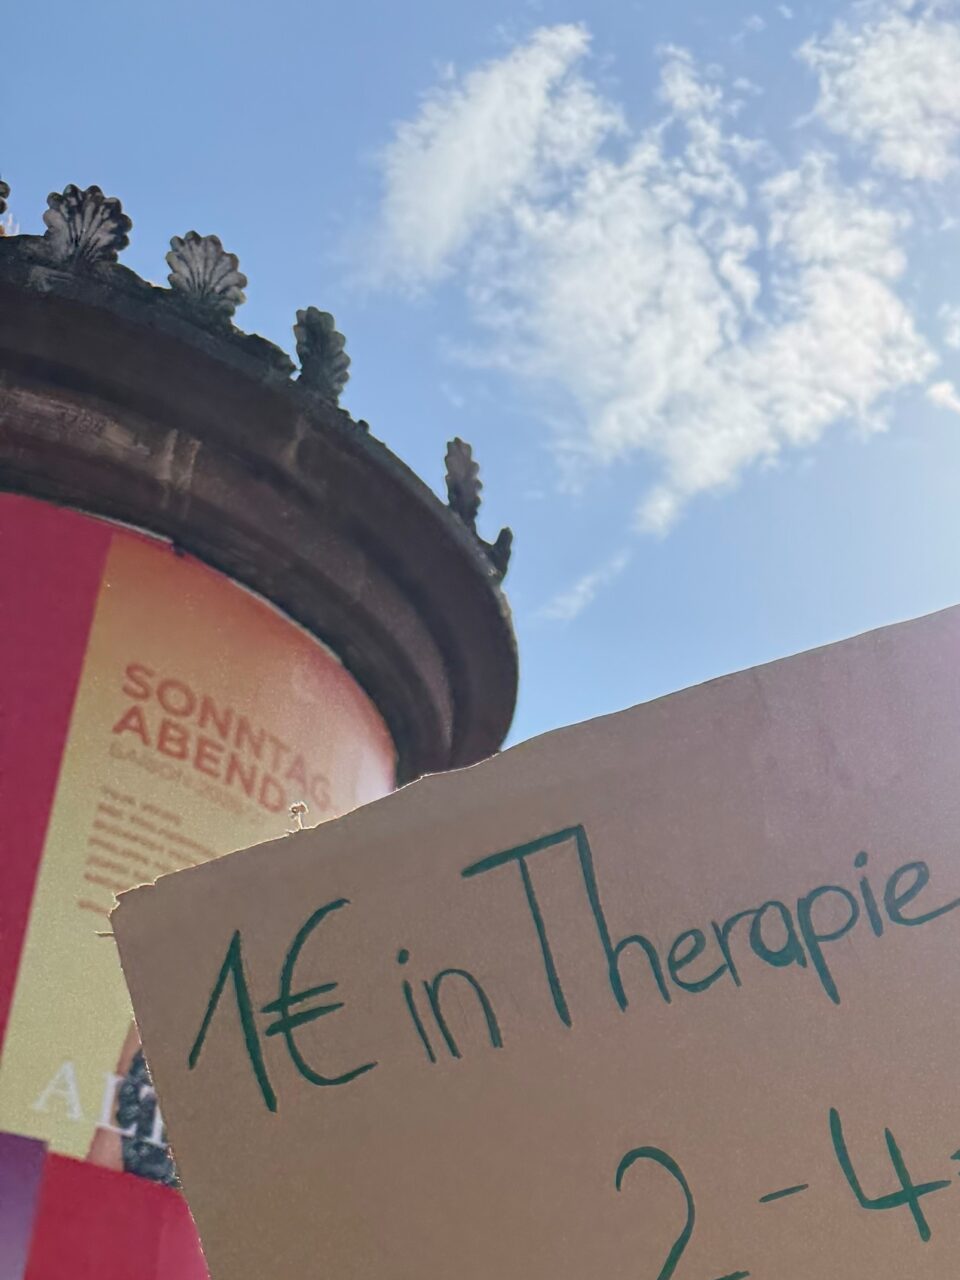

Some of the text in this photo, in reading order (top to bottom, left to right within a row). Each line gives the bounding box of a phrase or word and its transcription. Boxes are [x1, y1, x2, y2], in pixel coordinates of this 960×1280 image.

[111, 704, 287, 814] ABEND
[122, 661, 332, 812] SONNTAG
[188, 898, 376, 1113] 1€
[396, 948, 503, 1063] in
